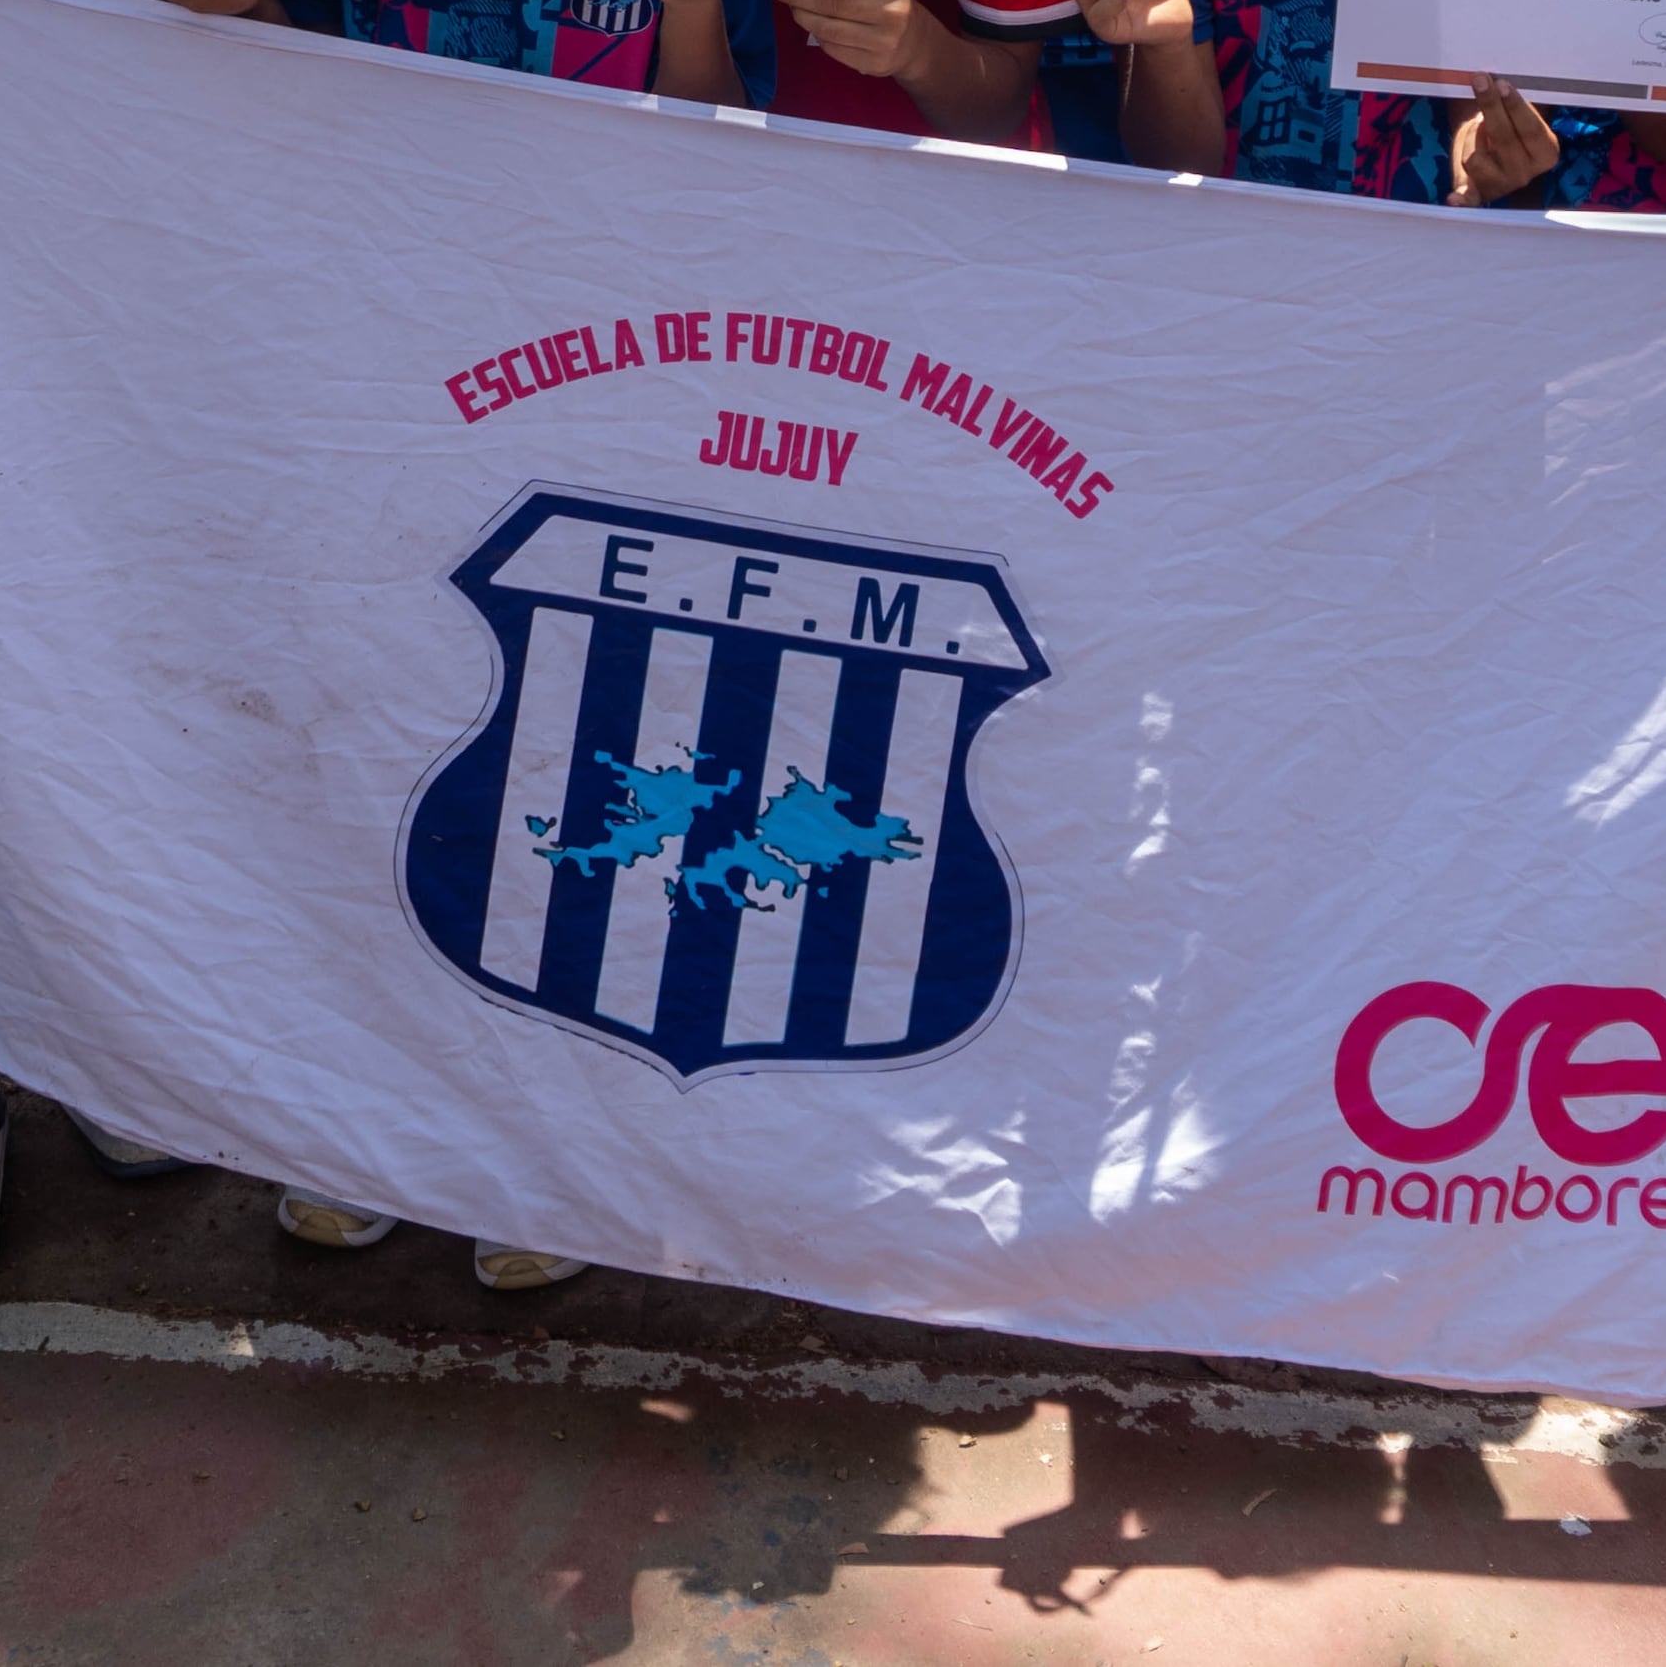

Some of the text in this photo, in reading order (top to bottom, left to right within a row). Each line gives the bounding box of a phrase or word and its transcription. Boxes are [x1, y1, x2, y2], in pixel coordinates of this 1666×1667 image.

[444, 310, 1117, 521] ESCUELA DE FUTBOL MALVINAS
[699, 409, 859, 487] JUJUY
